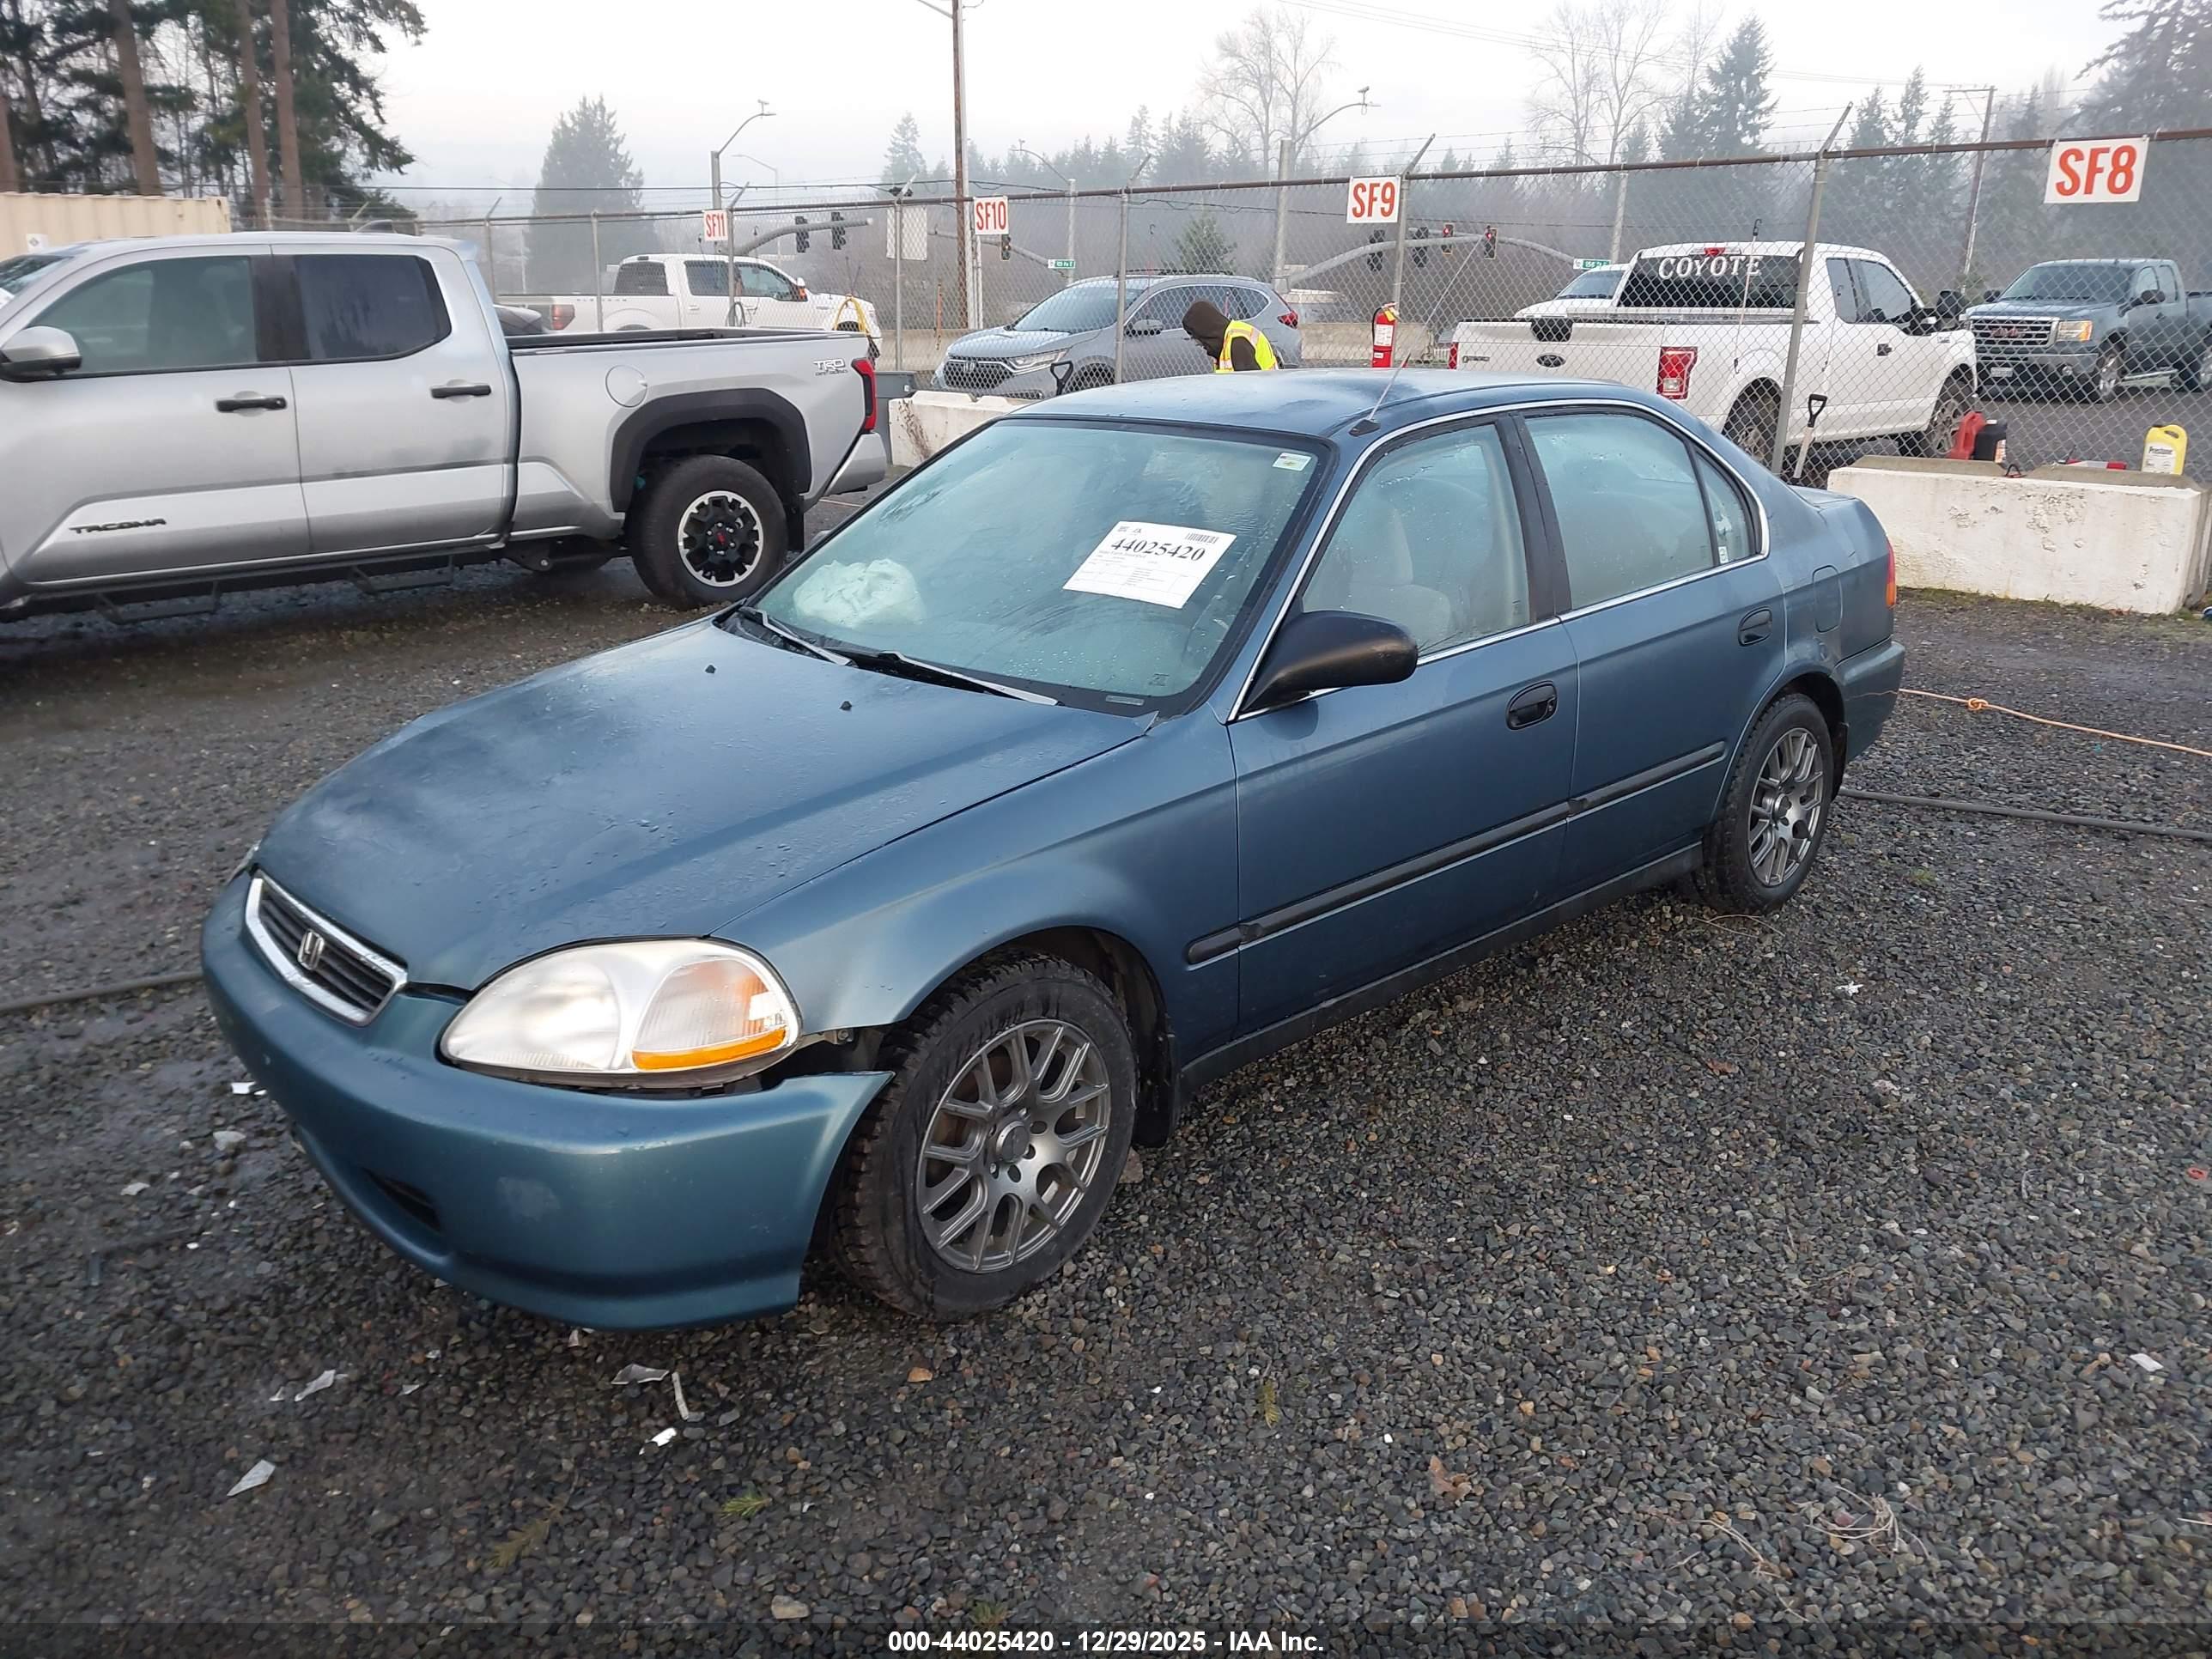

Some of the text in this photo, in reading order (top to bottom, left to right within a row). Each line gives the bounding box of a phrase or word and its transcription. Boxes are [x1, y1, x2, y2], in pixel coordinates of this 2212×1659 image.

[2056, 144, 2137, 196] SF8
[1352, 181, 1395, 217] SF9
[706, 213, 726, 237] SF11
[975, 201, 1006, 230] SF10
[1658, 256, 1763, 279] COYOTE
[812, 359, 846, 370] TRD
[69, 518, 167, 533] TACOMA
[1111, 538, 1206, 561] 44025420
